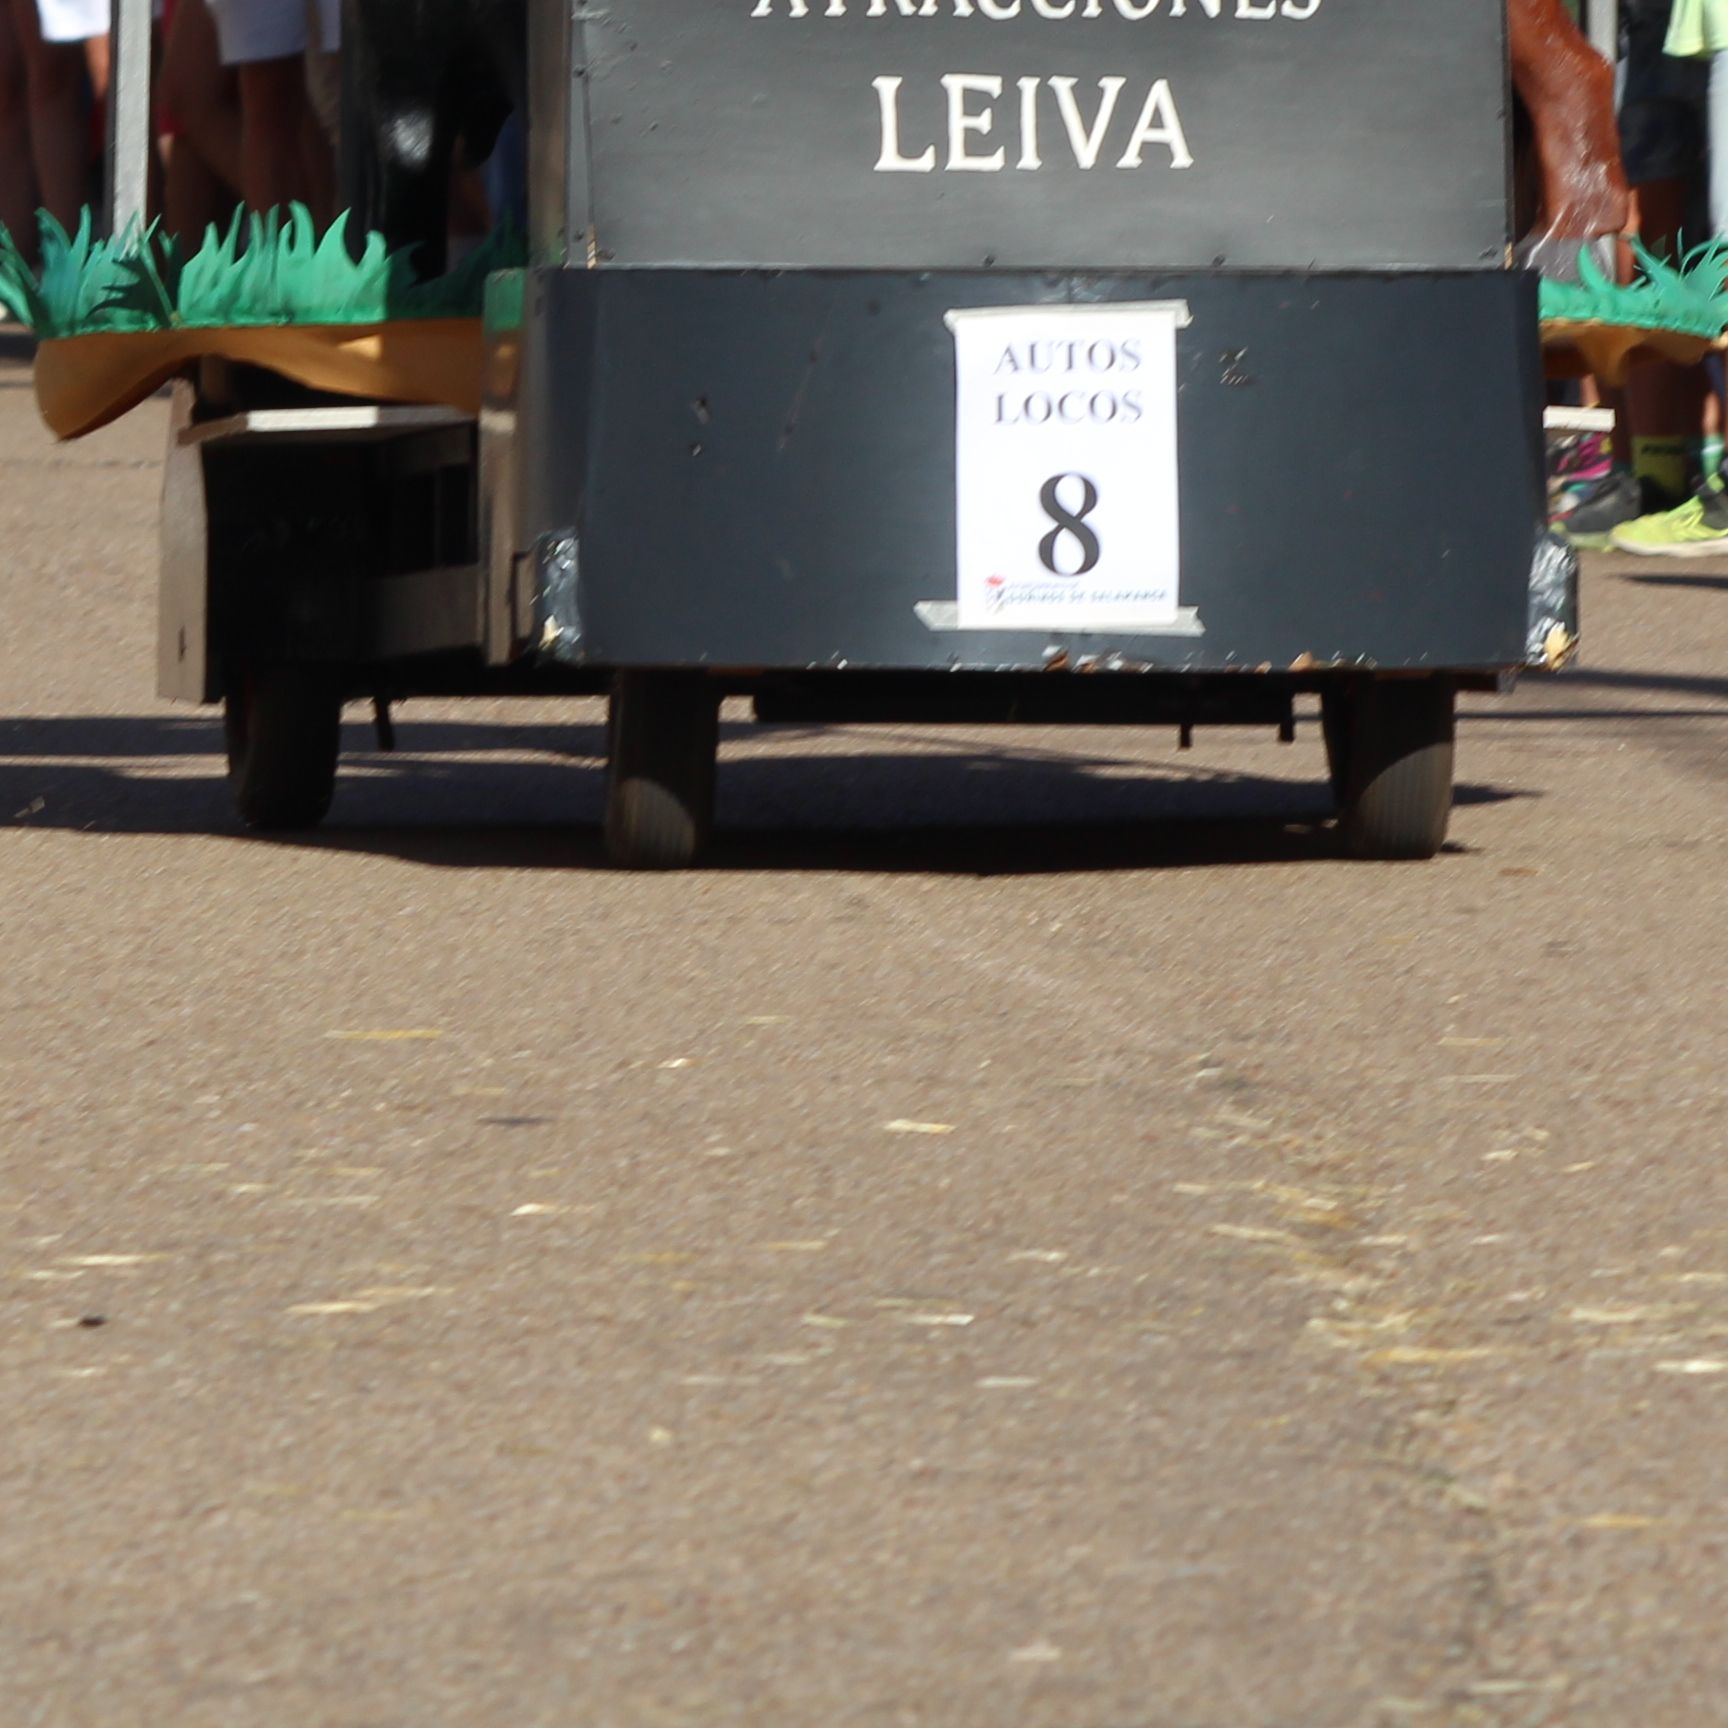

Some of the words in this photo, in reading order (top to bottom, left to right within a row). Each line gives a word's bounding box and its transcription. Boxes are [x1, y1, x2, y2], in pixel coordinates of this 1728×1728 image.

[871, 72, 1195, 173] LEIVA
[993, 338, 1143, 375] AUTOS
[993, 389, 1144, 425] LOCOS
[1038, 470, 1101, 578] 8
